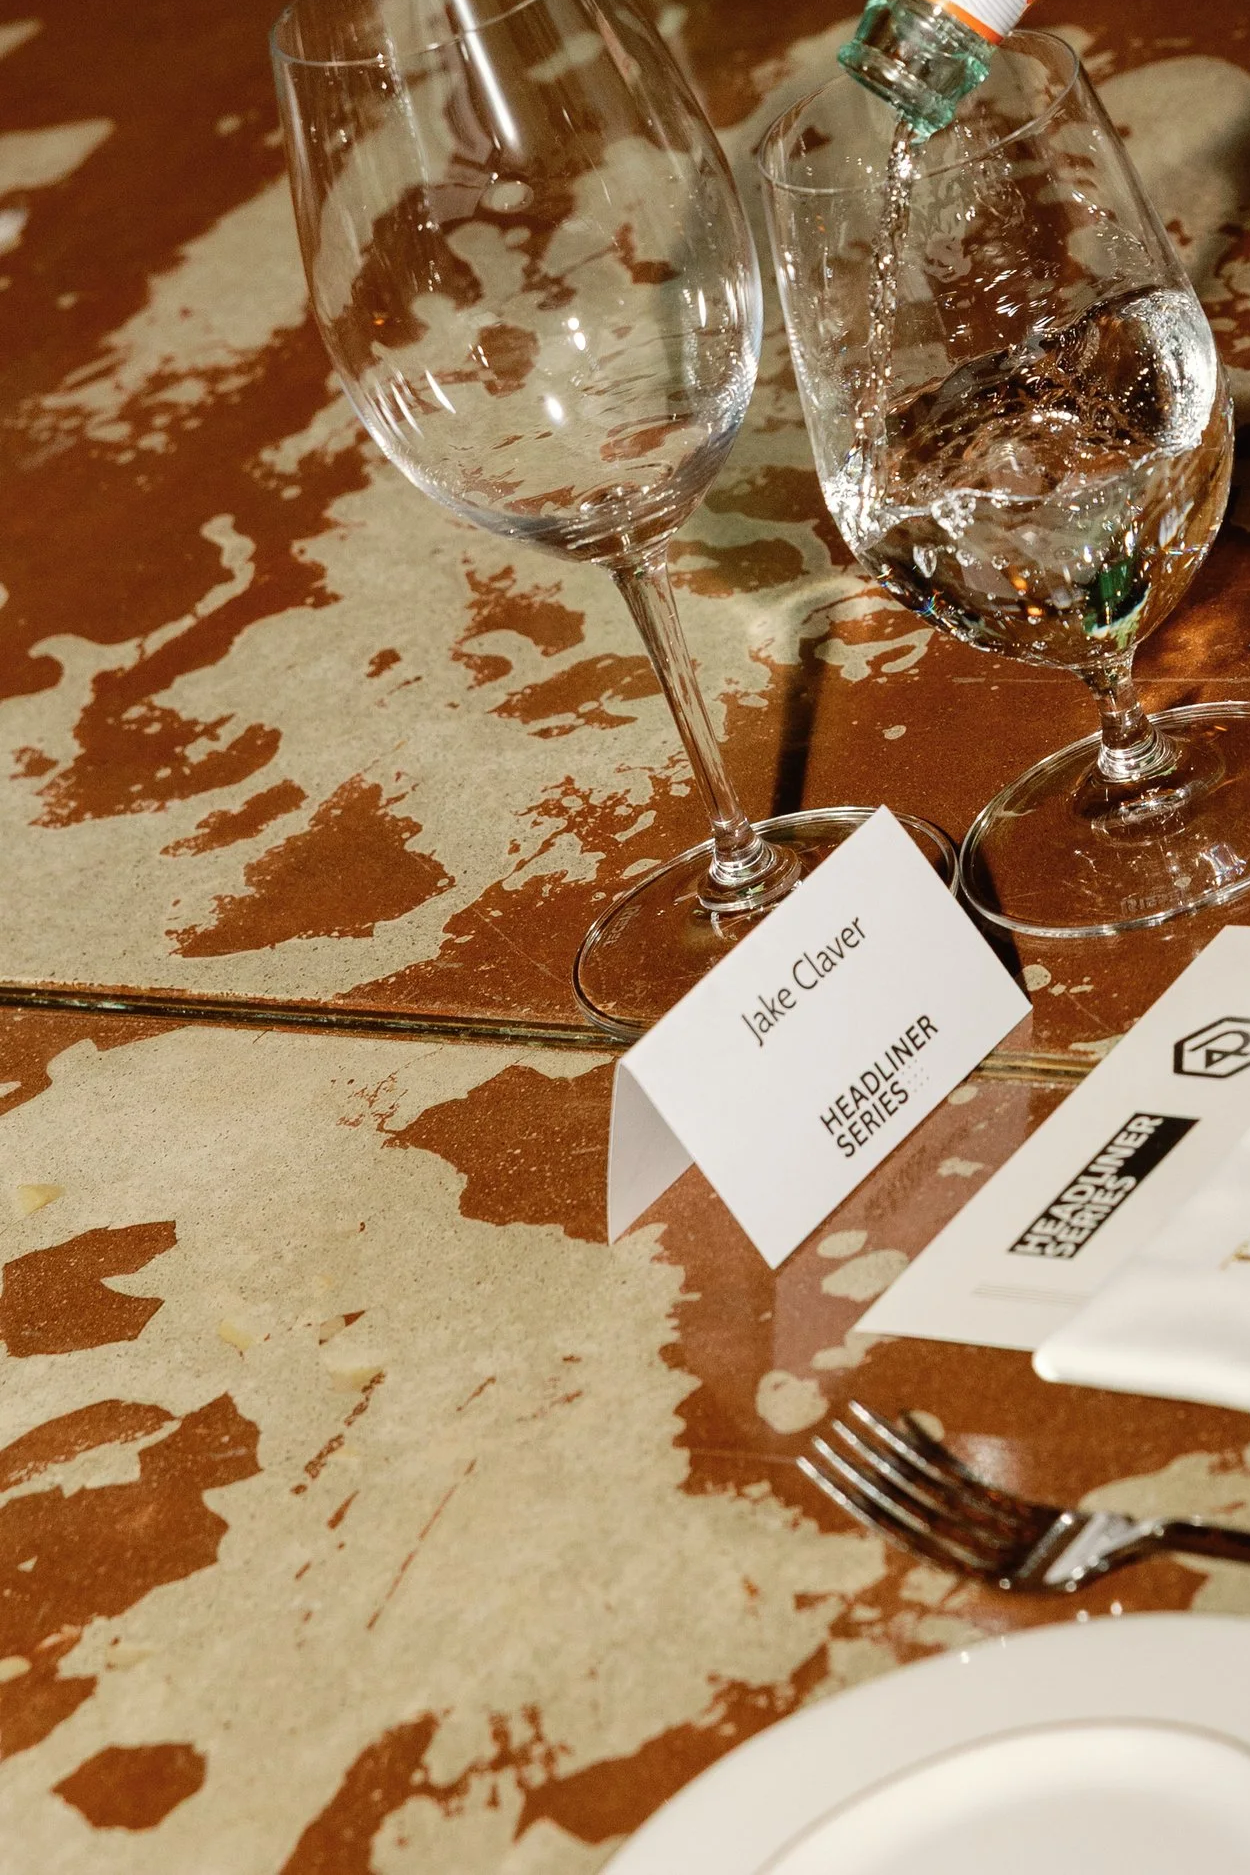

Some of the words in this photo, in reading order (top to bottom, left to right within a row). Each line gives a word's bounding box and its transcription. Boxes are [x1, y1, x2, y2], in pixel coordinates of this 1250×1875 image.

[741, 987, 798, 1048] Jake
[792, 916, 866, 990] Claver
[819, 1014, 939, 1136] HEADLINER
[836, 1080, 910, 1158] SERIES
[1014, 1114, 1164, 1255] HEADLINER
[1044, 1174, 1137, 1258] SERIES
